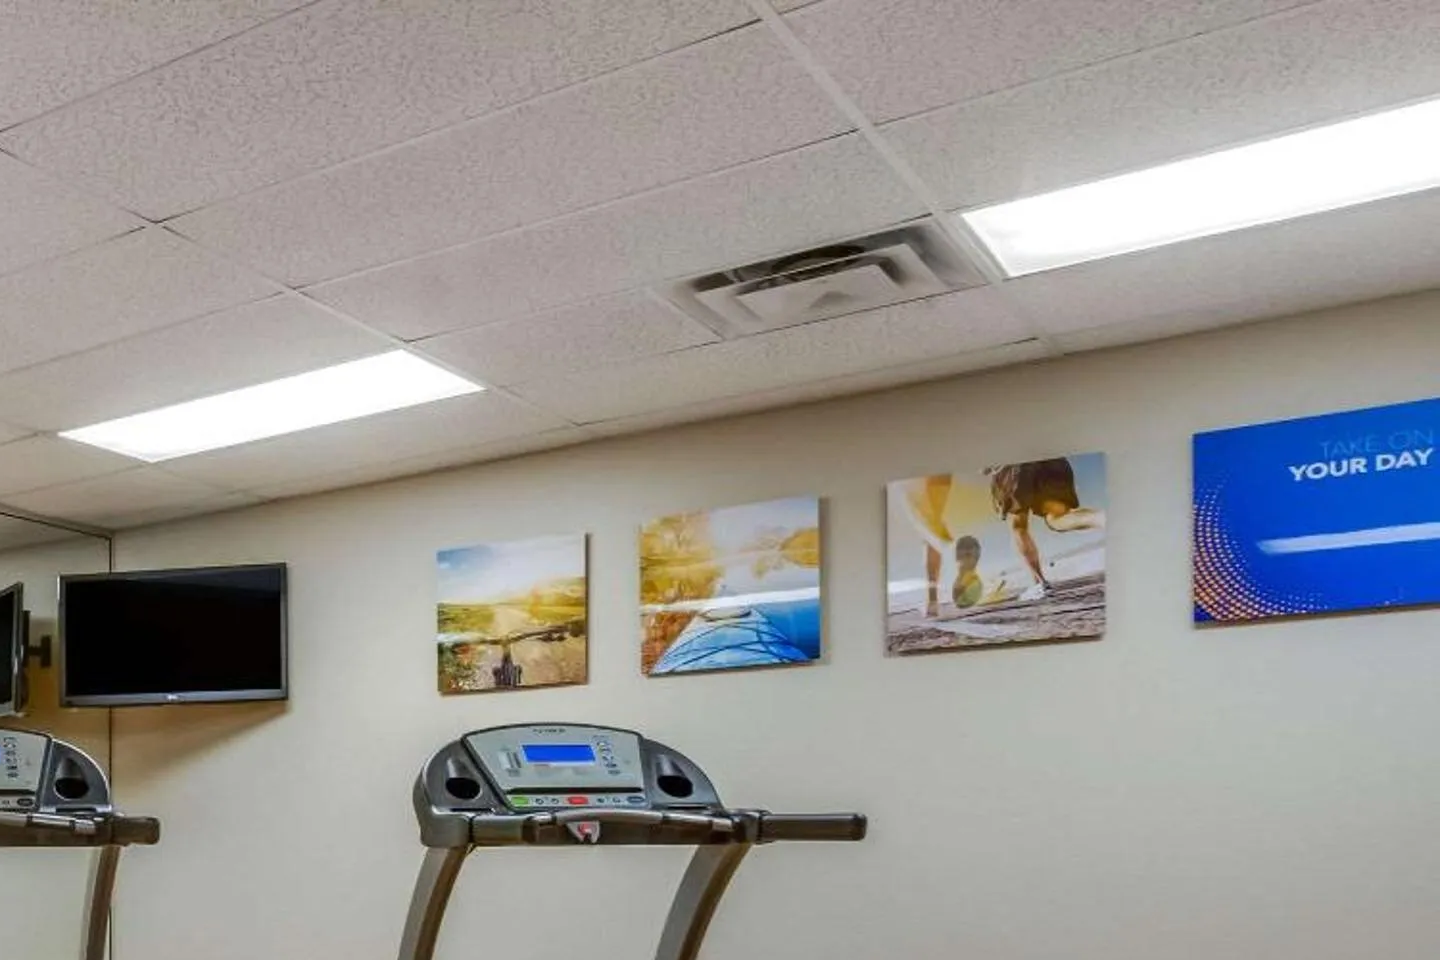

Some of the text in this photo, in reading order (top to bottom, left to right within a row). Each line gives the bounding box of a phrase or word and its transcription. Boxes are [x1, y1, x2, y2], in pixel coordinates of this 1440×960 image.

[1321, 429, 1433, 459] TAKE ON
[1288, 447, 1434, 481] YOUR DAY
